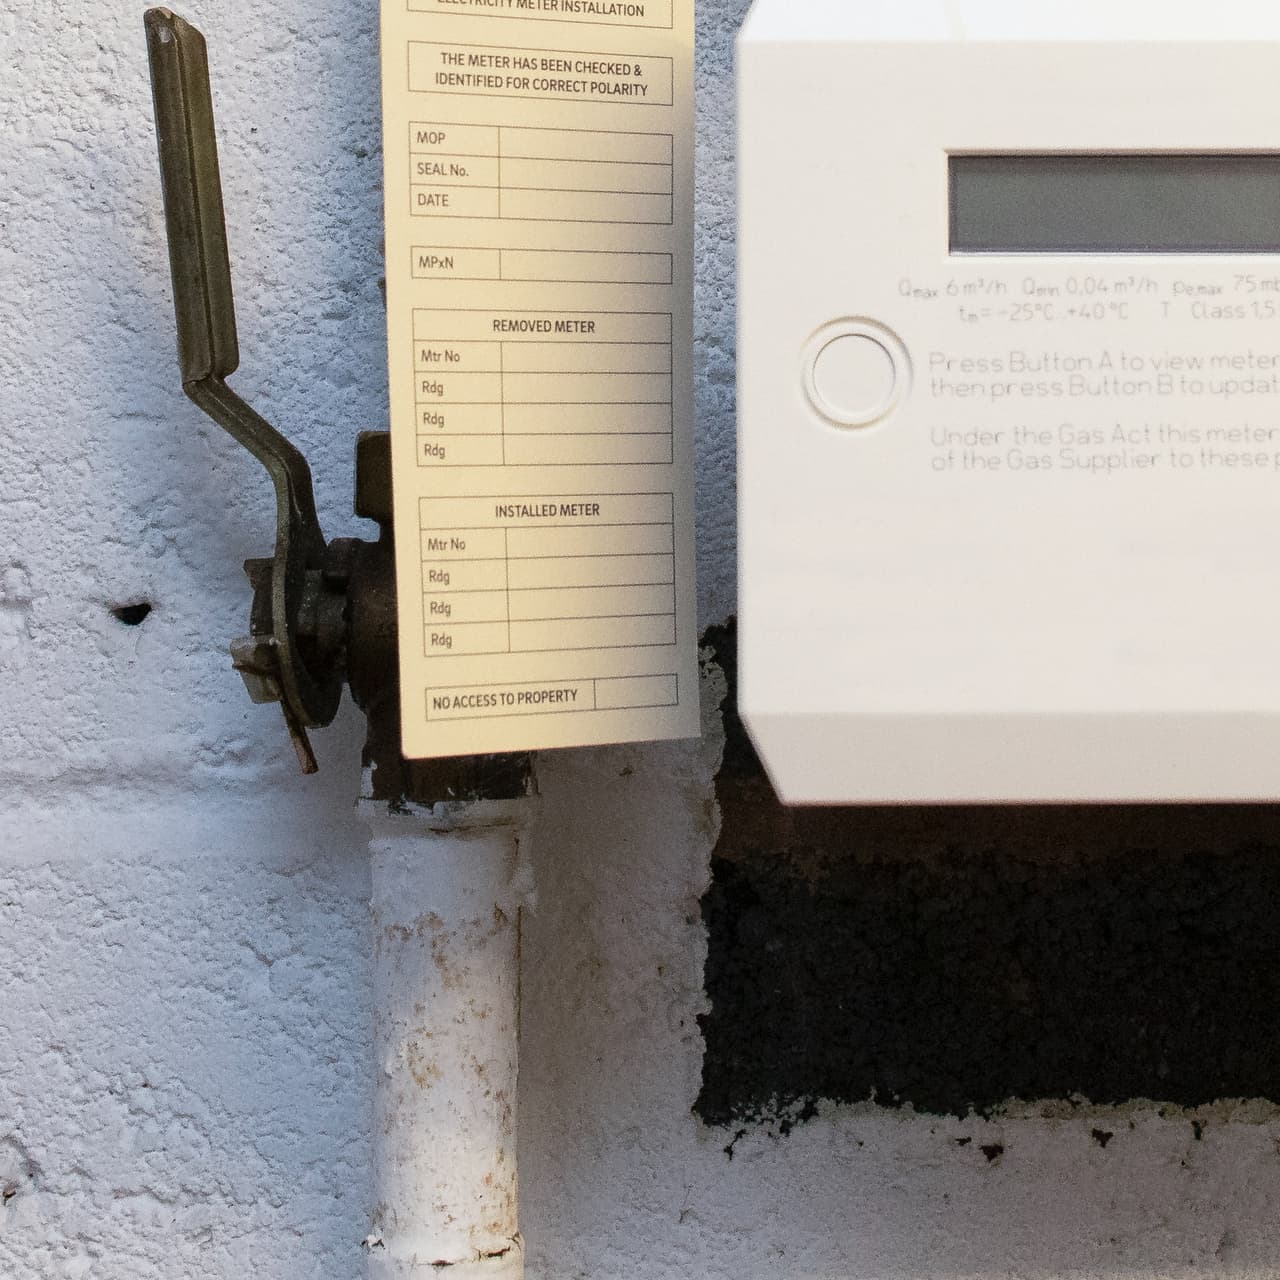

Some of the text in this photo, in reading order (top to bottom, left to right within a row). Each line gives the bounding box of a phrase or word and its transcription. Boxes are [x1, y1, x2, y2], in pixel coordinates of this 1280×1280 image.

[561, 0, 644, 16] INSTALLATION
[441, 52, 642, 76] THE METER HAS BEEN CHECKED &
[436, 72, 648, 96] IDENTIFIED FOR CORRECT POLARITY
[417, 131, 445, 144] MOP
[417, 162, 469, 176] SEAL No.
[418, 193, 448, 207] DATE
[419, 256, 453, 269] MPxN
[493, 320, 595, 333] REMOVED METER
[421, 349, 460, 362] Mtr No
[928, 352, 1004, 372] Press
[1009, 351, 1093, 372] Button
[1098, 350, 1114, 369] A
[1120, 352, 1144, 371] to
[1150, 350, 1204, 370] view
[422, 381, 443, 397] Rdg
[931, 378, 986, 397] then
[990, 382, 1064, 402] press
[1069, 374, 1152, 396] Button
[1157, 373, 1173, 394] B
[1180, 375, 1204, 394] to
[423, 412, 444, 428] Rdg
[929, 427, 1006, 446] Under
[1013, 426, 1053, 446] the
[1058, 423, 1105, 445] Gas
[1111, 423, 1151, 445] Act
[1158, 424, 1203, 444] this
[1206, 424, 1280, 443] meter
[424, 443, 445, 460] Rdg
[963, 451, 1002, 470] the
[1007, 448, 1053, 470] Gas
[1058, 448, 1162, 474] Supplier
[1168, 448, 1194, 468] to
[1200, 448, 1269, 467] these
[496, 504, 599, 517] INSTALLED METER
[428, 538, 466, 551] Mtr No
[429, 569, 450, 585] Rdg
[430, 601, 451, 617] Rdg
[432, 633, 452, 649] Rdg
[433, 689, 577, 710] NO ACCESS TO PROPERTY
